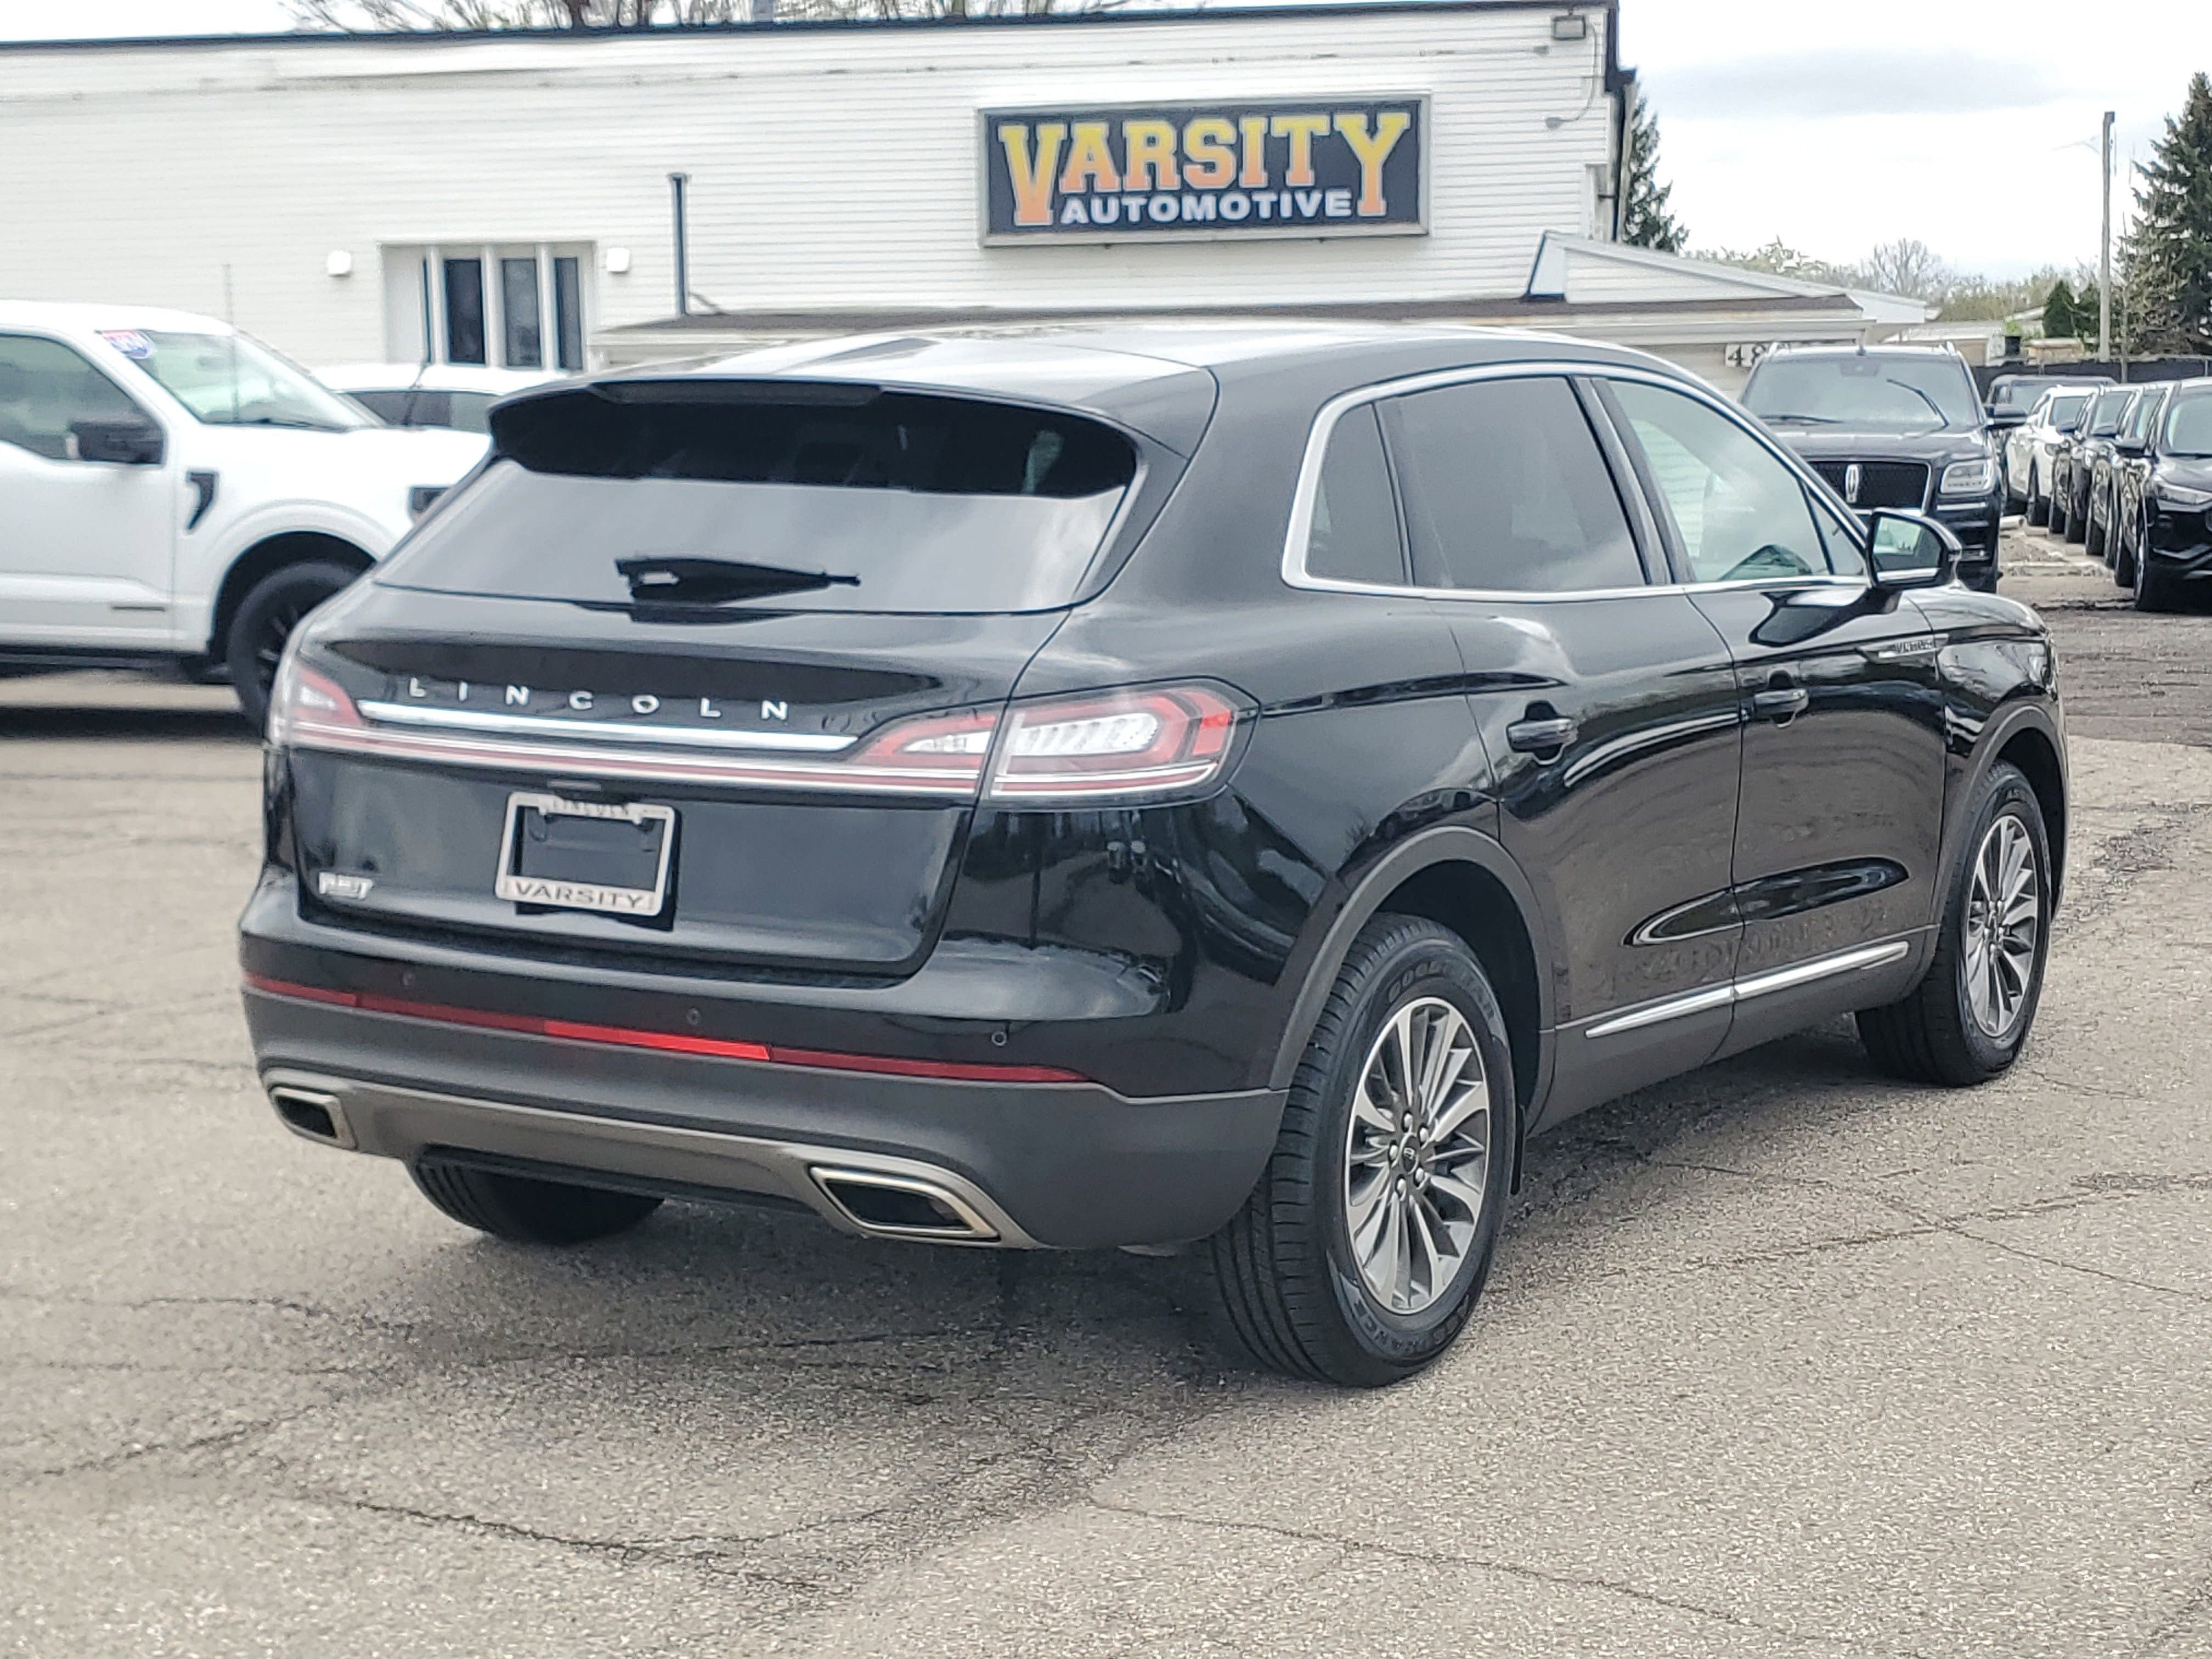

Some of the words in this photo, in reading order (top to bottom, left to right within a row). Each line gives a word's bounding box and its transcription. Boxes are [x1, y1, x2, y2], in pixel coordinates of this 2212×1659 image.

[997, 112, 1410, 226] VARSITY
[1059, 190, 1352, 224] AUTOMOTIVE
[409, 678, 788, 721] LINCOLN
[515, 881, 644, 909] VARSITY
